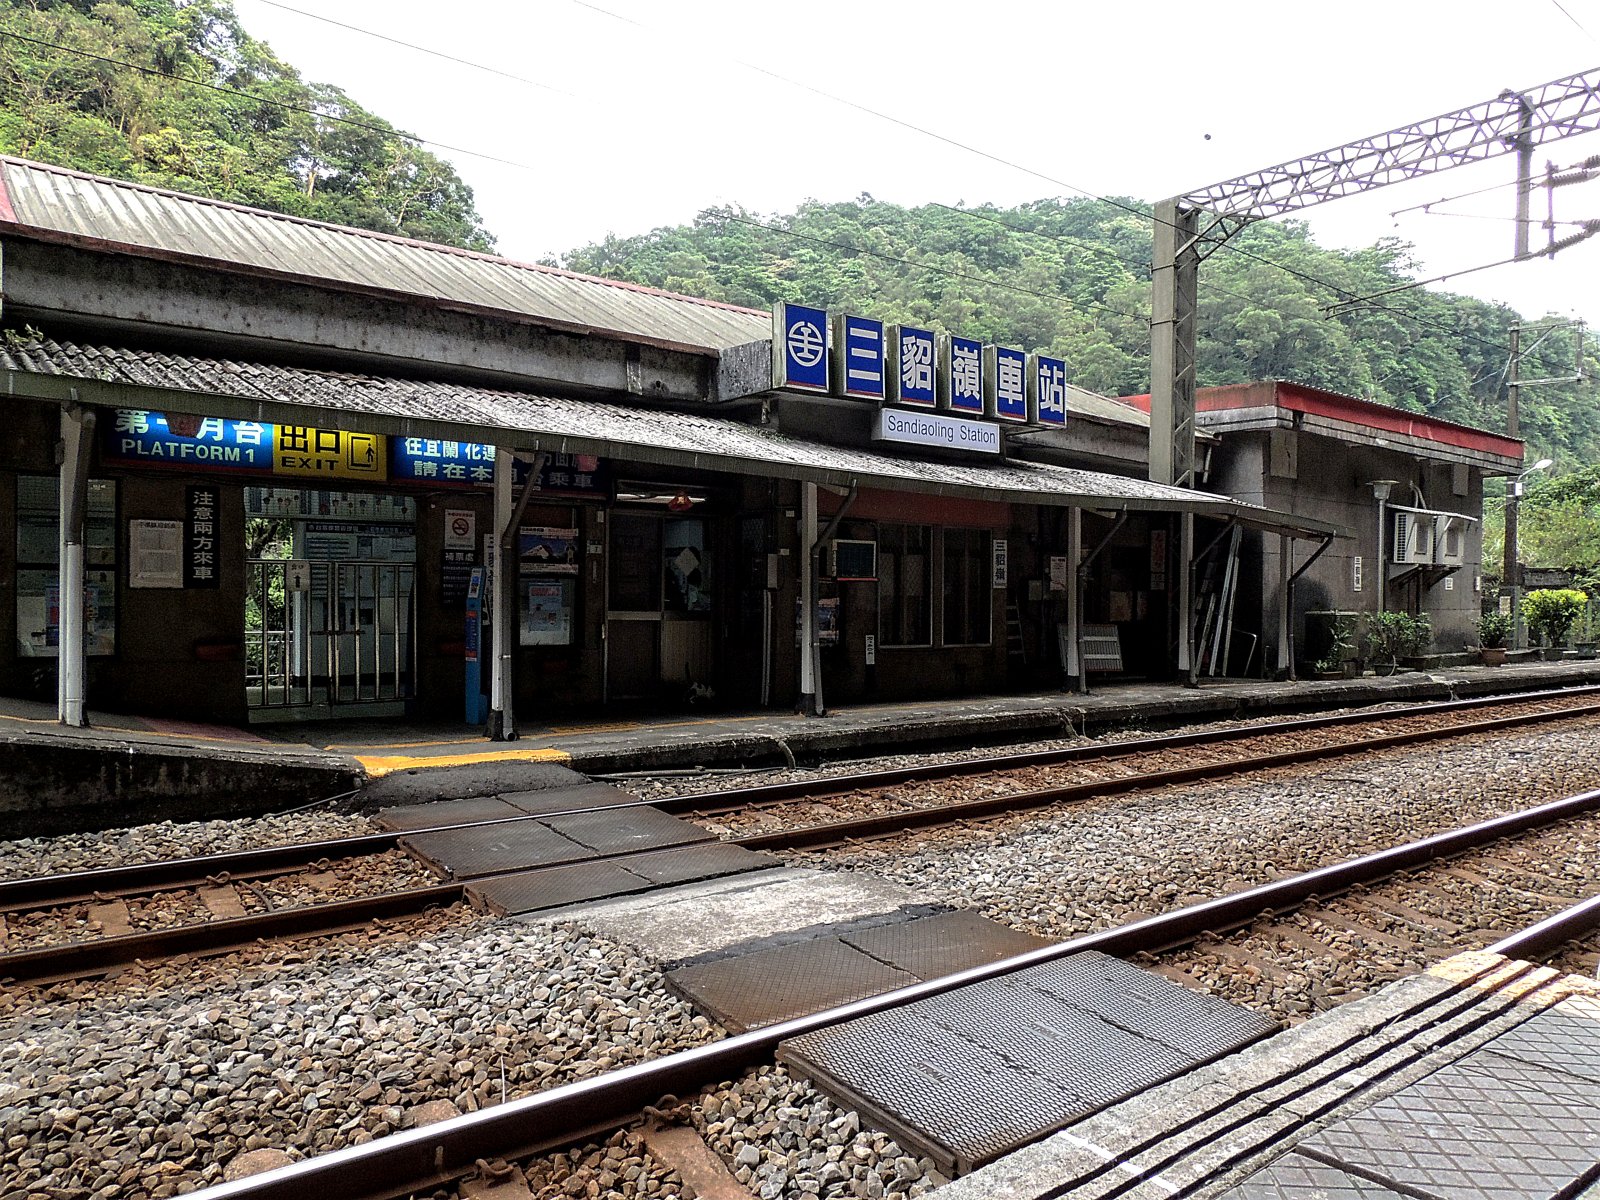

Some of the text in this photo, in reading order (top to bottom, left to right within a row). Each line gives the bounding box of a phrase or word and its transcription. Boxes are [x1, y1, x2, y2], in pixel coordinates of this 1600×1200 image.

[849, 327, 1064, 414] 三貂嶺車站
[115, 409, 265, 446] 第月台
[280, 424, 341, 454] 出口
[887, 414, 996, 444] Sandiaoling Station
[121, 438, 254, 463] PLATFORM 1
[281, 455, 340, 471] EXIT
[192, 491, 214, 580] 注意兩方來車
[995, 541, 1006, 581] 三貂嶺
